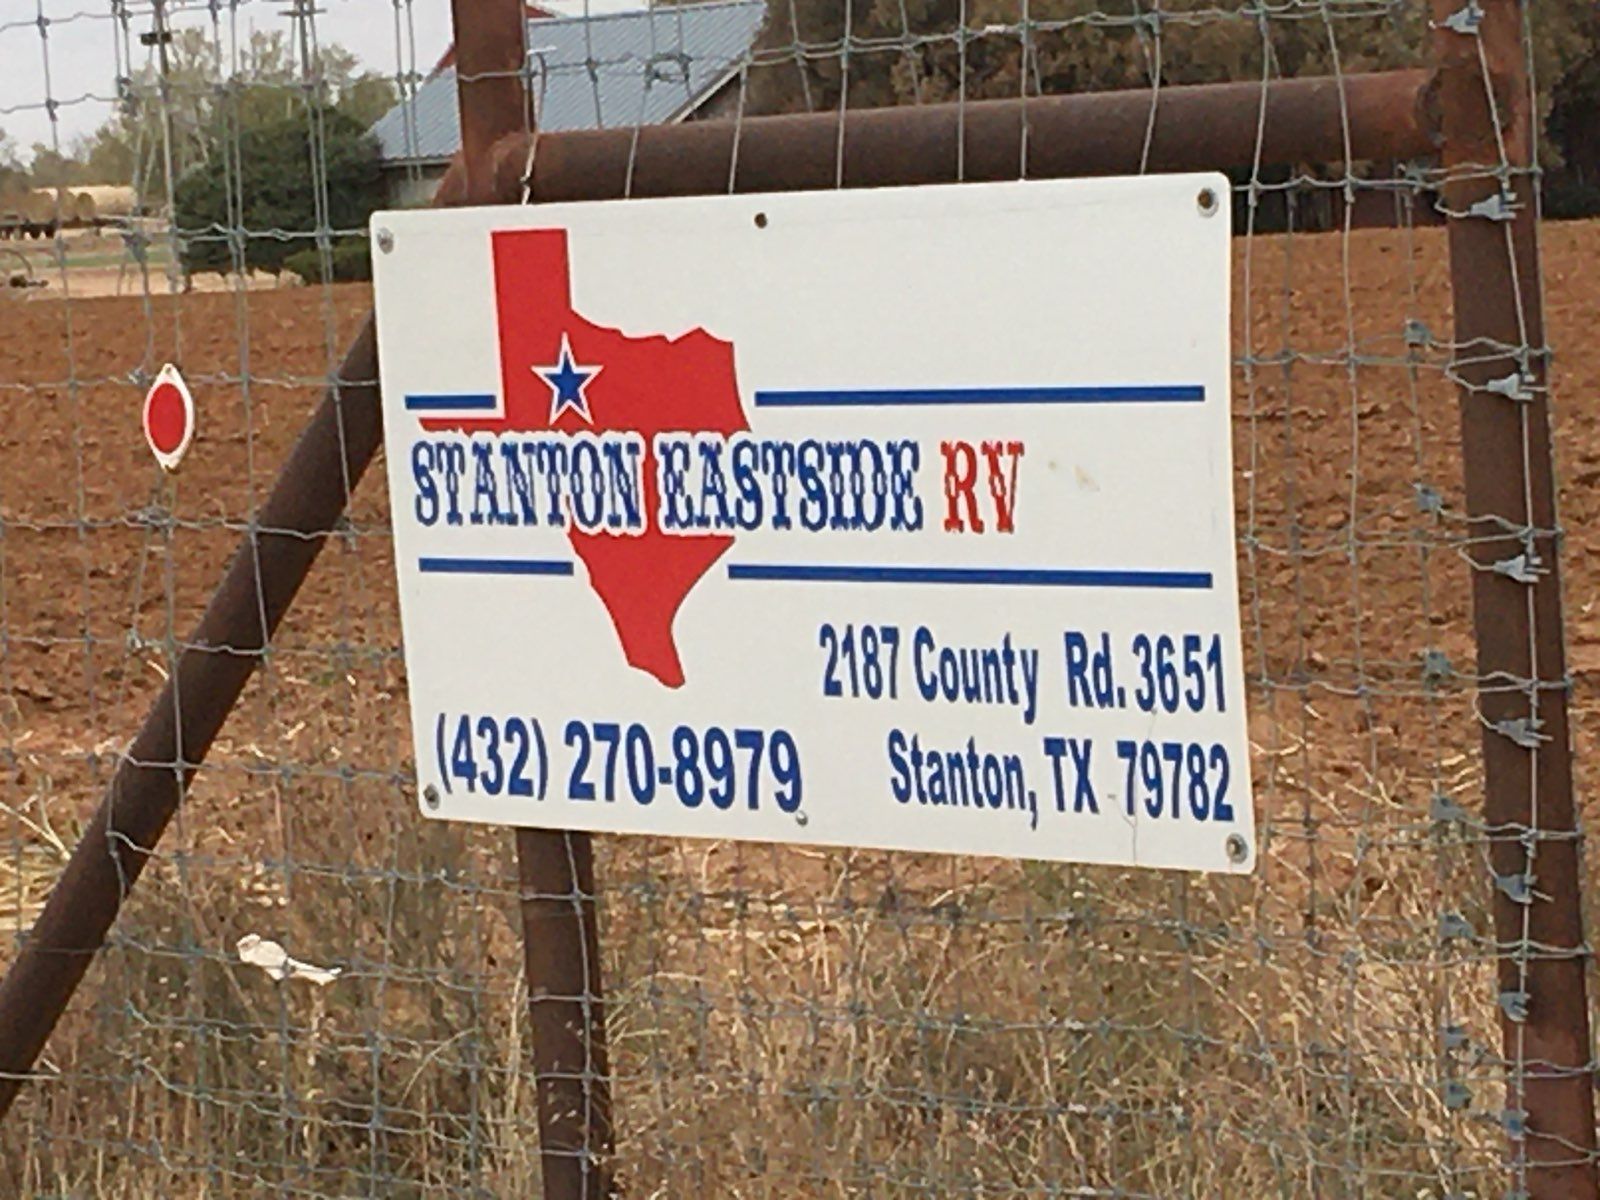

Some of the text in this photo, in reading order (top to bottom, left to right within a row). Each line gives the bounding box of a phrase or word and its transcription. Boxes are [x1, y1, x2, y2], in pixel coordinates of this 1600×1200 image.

[412, 439, 1023, 533] STANTON EASTSIDE RV
[819, 623, 899, 700] 2187
[913, 626, 1037, 724] County
[436, 713, 802, 811] (432) 270-8979
[888, 729, 1233, 830] Stanton, TX 79782
